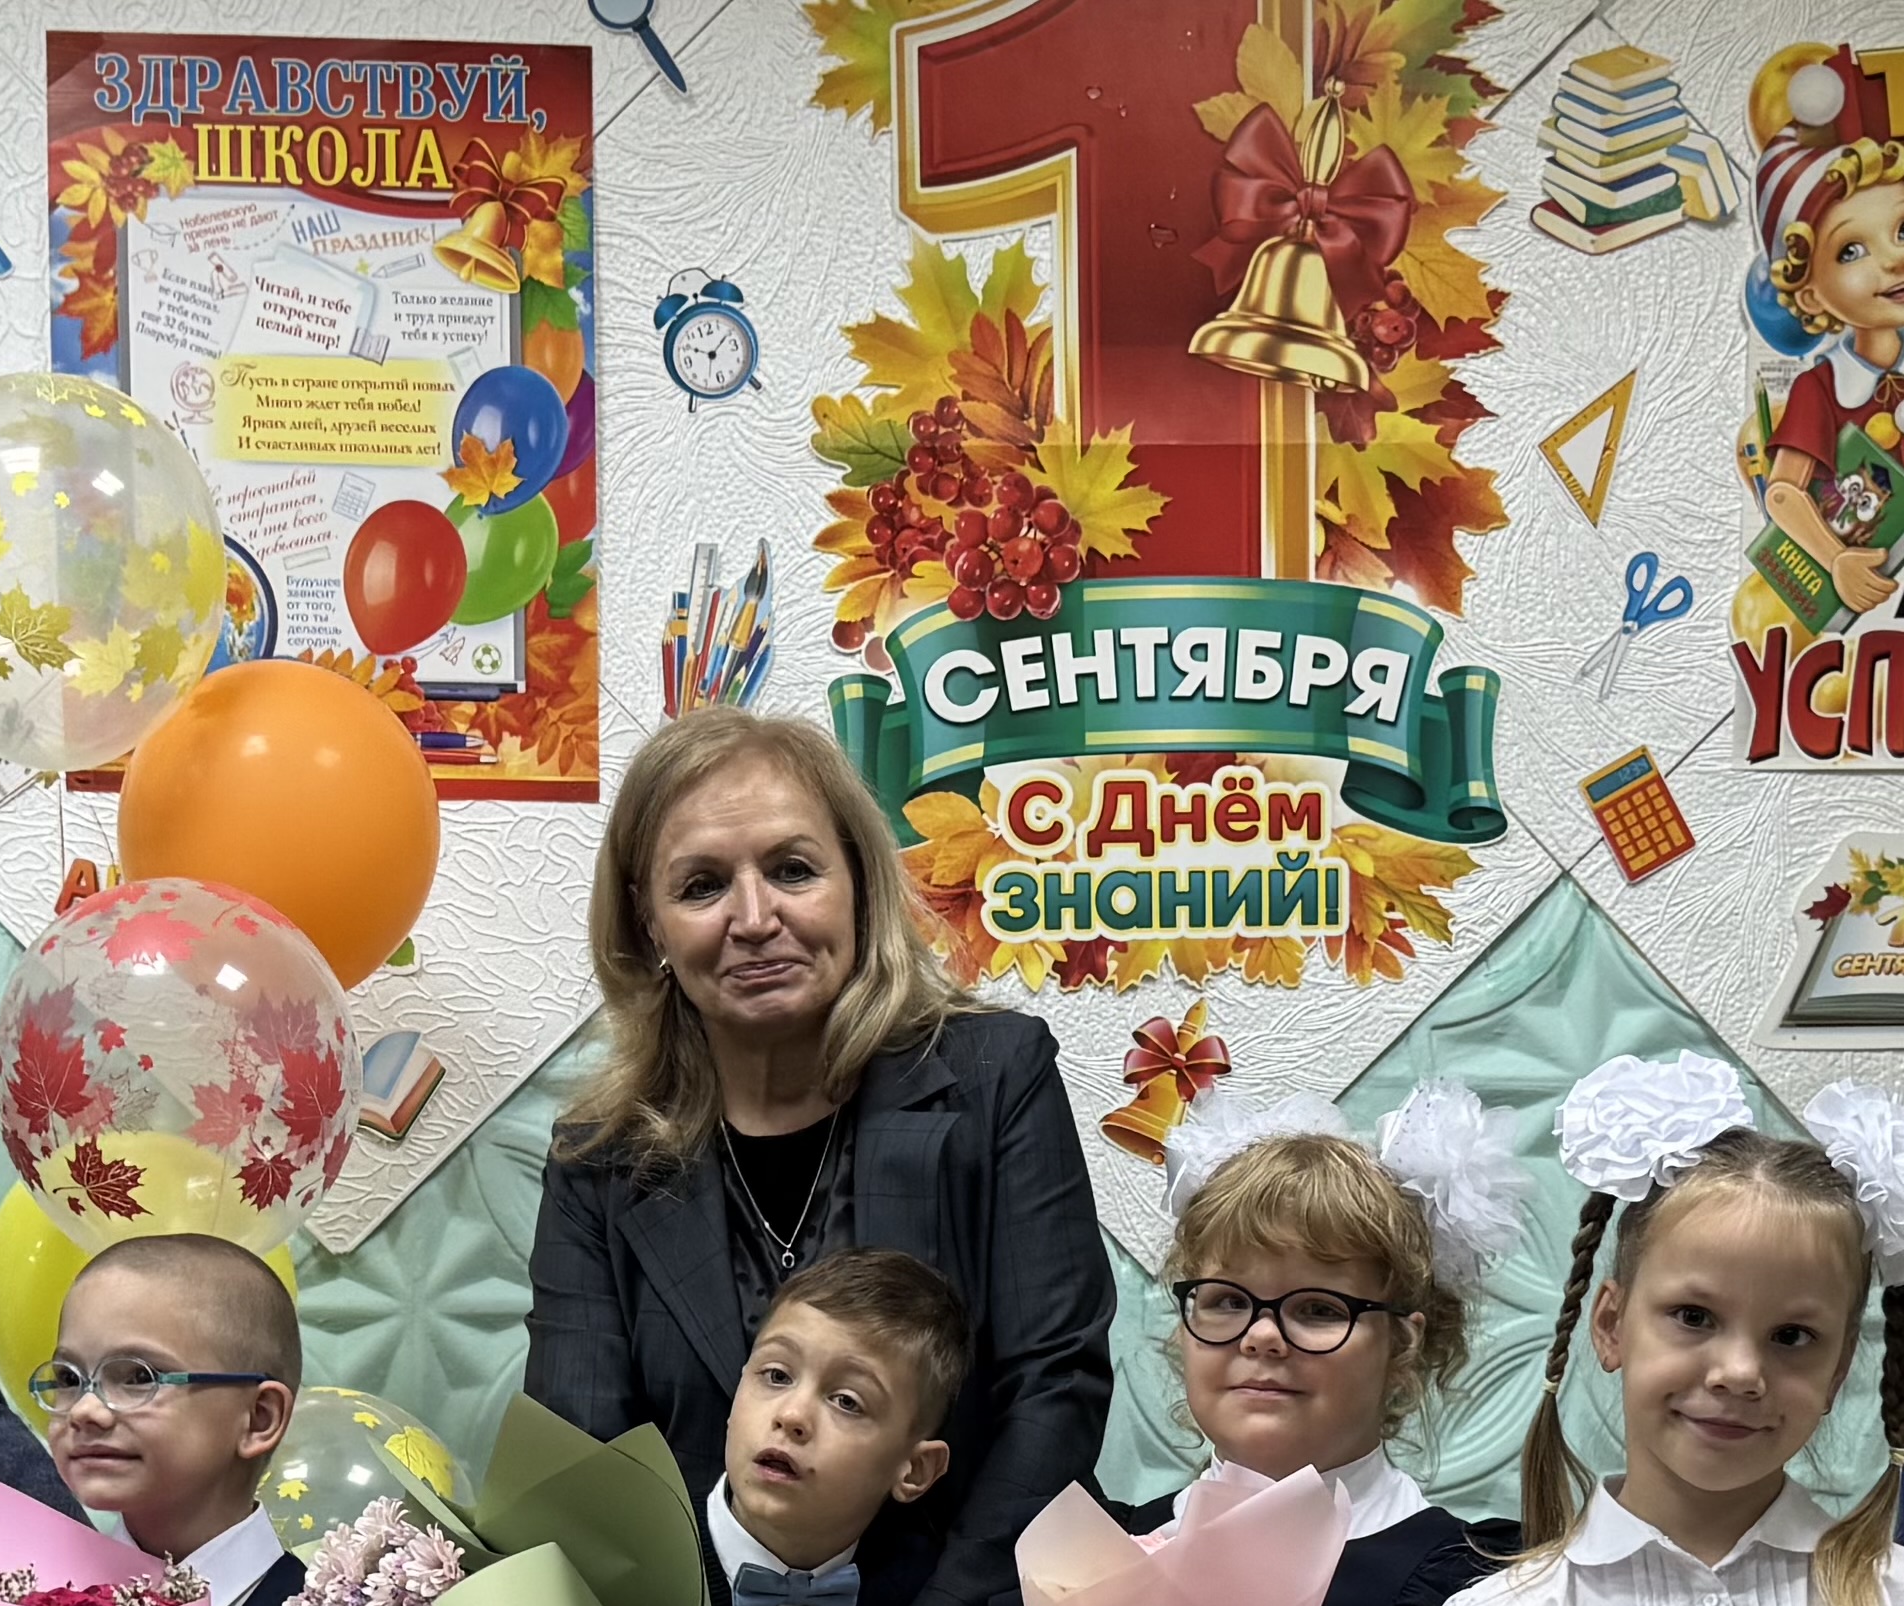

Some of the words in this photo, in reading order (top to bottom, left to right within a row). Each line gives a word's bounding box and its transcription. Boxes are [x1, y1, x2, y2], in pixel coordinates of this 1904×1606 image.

[93, 52, 547, 133] ЗДРАВСТВУЙ,
[193, 123, 454, 190] ШКОЛА
[291, 208, 341, 244] НАШ
[311, 223, 437, 256] ПРАЗДНИК!
[255, 275, 303, 303] Читай,
[308, 294, 317, 306] и
[321, 298, 352, 315] тебе
[392, 290, 437, 305] Только
[440, 295, 493, 307] желание
[263, 301, 337, 329] откроется
[394, 312, 402, 322] и
[406, 312, 434, 327] труд
[438, 312, 495, 328] приведут
[256, 316, 303, 338] целый
[306, 330, 341, 350] мир!
[401, 328, 428, 341] тебя
[432, 332, 439, 341] к
[442, 329, 488, 346] успеху!
[697, 322, 713, 339] 12
[728, 339, 739, 352] 3
[683, 355, 693, 369] 9
[220, 362, 278, 392] Пусть
[281, 378, 289, 388] в
[292, 377, 339, 395] стране
[341, 377, 409, 395] открытий
[412, 381, 456, 393] новых
[715, 371, 725, 384] 6
[256, 394, 302, 410] Много
[344, 397, 374, 411] тебя
[377, 397, 421, 413] побед!
[242, 416, 286, 433] Ярких
[289, 417, 327, 433] дней,
[330, 418, 376, 436] друзей
[238, 436, 250, 450] И
[255, 439, 336, 453] счастливых
[339, 442, 412, 455] школьных
[1776, 539, 1824, 597] КНИГА
[286, 575, 341, 590] Будущее
[287, 601, 300, 610] от
[306, 601, 336, 613] того,
[287, 613, 309, 622] что
[287, 625, 342, 637] делаешь
[287, 637, 342, 648] сегодня.
[924, 627, 1413, 723] СЕНТЯБРЯ
[1006, 779, 1065, 847] С
[1088, 772, 1323, 858] Днём
[992, 852, 1340, 932] знаний!
